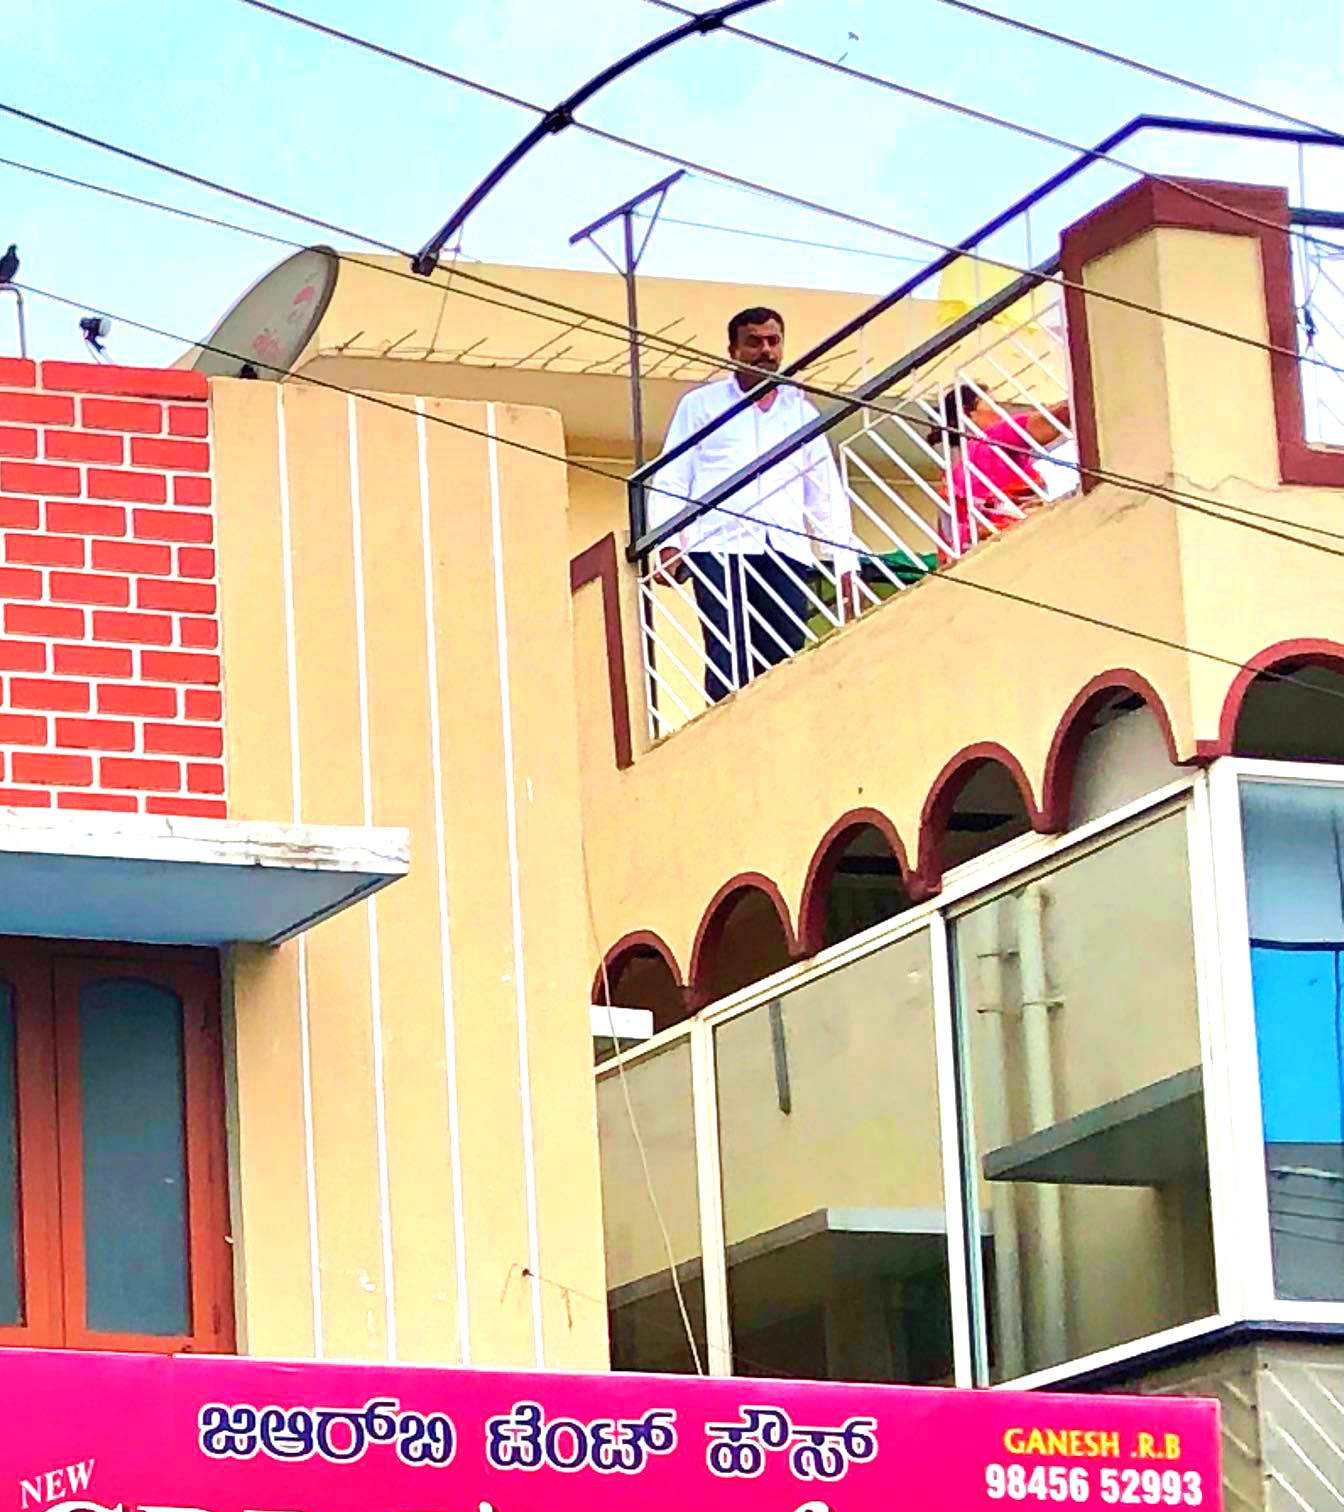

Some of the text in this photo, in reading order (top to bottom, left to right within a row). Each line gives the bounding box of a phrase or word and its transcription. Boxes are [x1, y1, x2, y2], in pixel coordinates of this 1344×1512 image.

[1003, 1427, 1120, 1459] GANESH
[19, 1459, 96, 1508] NEW
[985, 1463, 1203, 1506] 98456 52993
